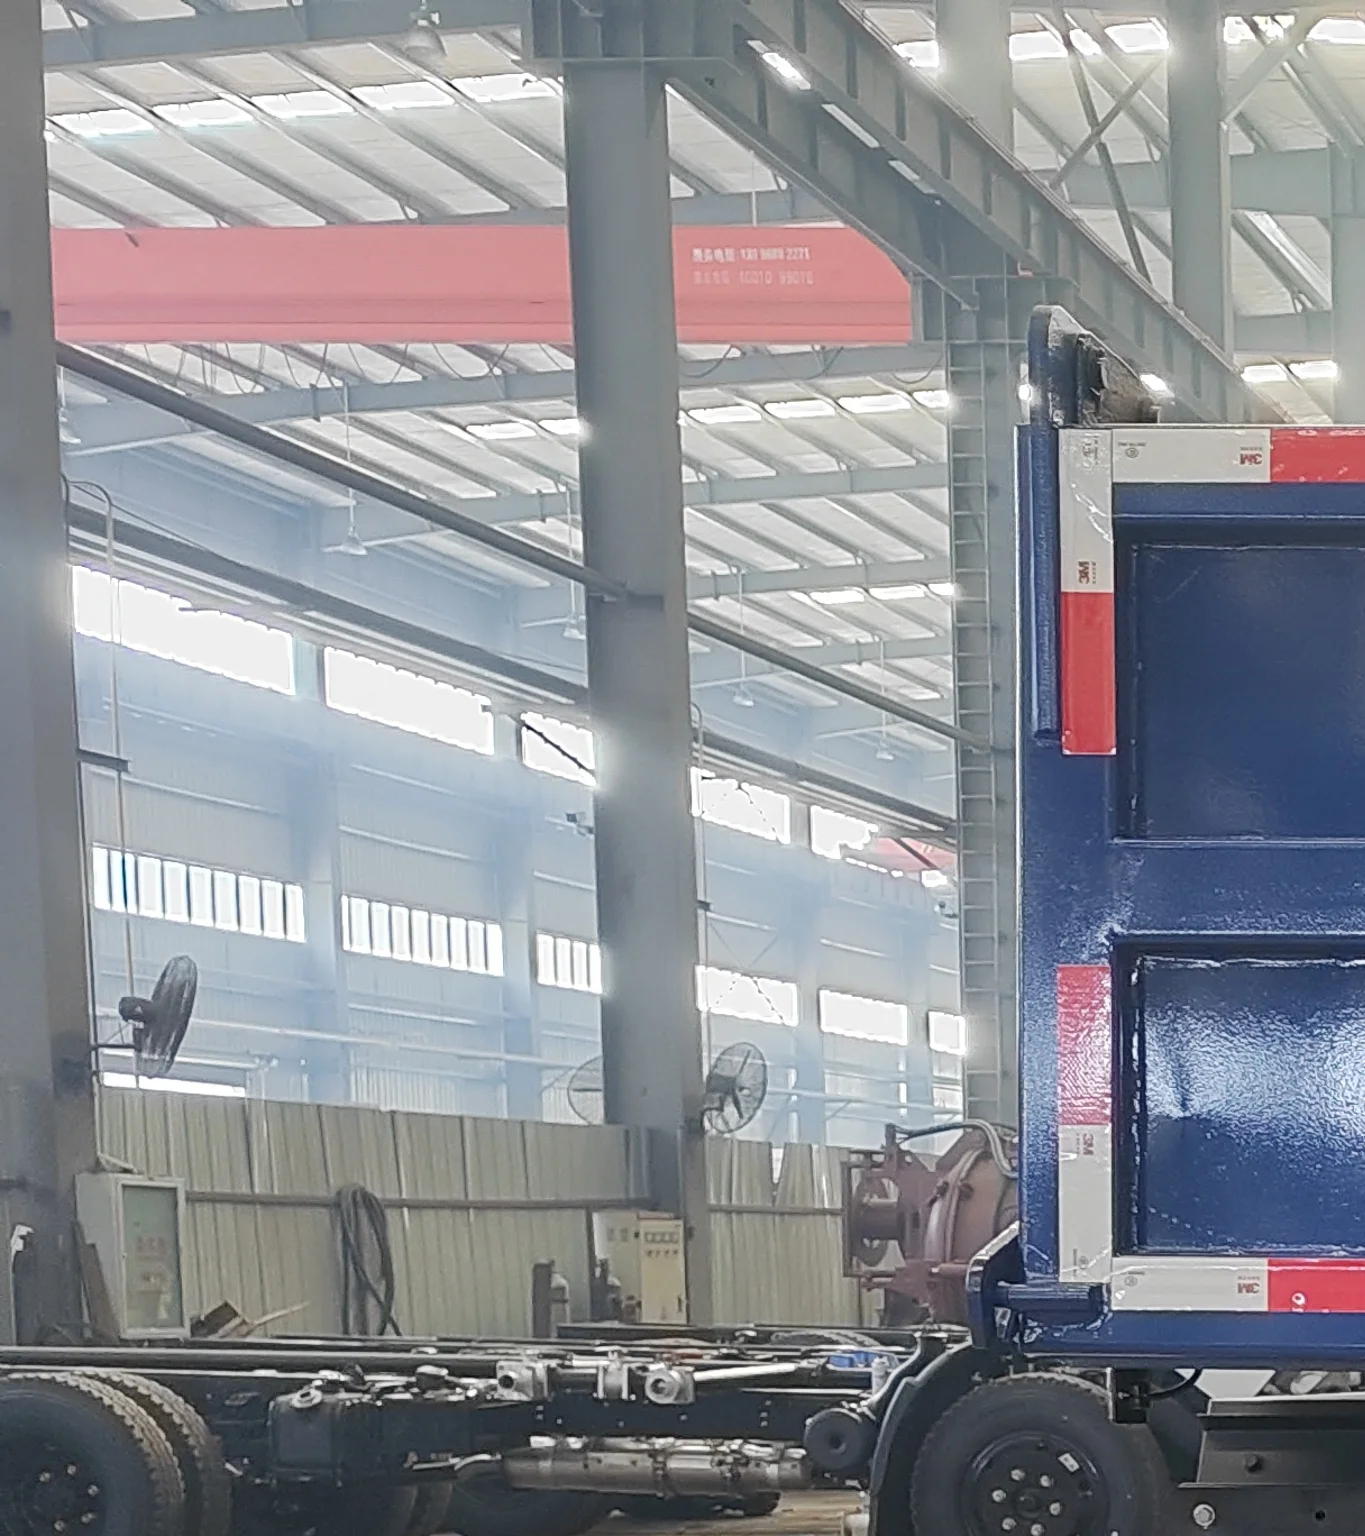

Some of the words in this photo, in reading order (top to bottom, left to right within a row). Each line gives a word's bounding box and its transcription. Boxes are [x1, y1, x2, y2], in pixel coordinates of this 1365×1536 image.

[1239, 452, 1263, 466] 3M
[1077, 561, 1091, 585] 3M
[1082, 1132, 1094, 1156] 3M
[1237, 1281, 1260, 1294] 3M
